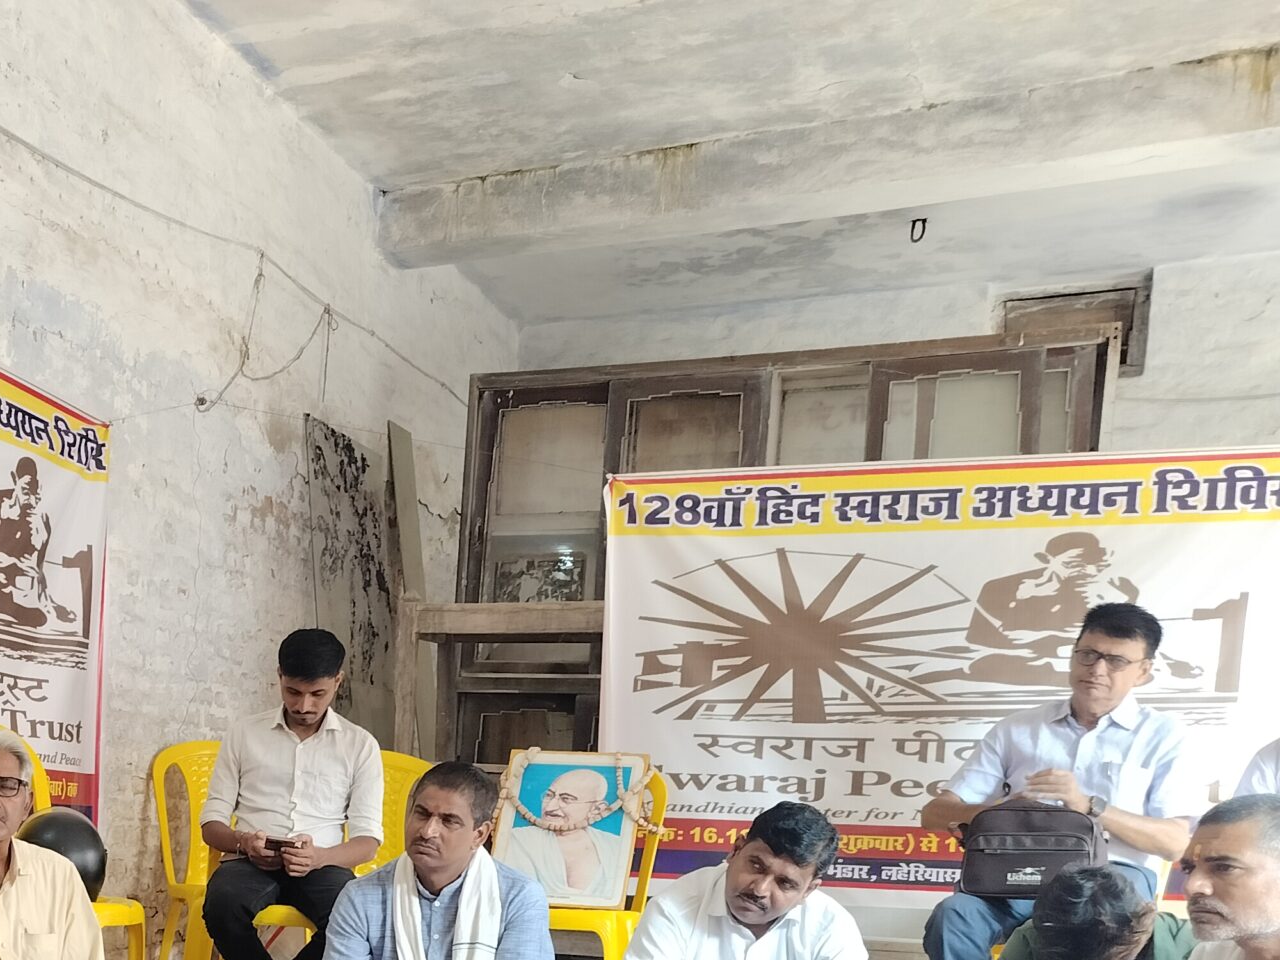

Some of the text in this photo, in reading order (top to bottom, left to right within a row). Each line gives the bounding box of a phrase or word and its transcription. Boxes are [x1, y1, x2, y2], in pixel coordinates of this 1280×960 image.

[754, 484, 826, 527] हिंद
[834, 488, 964, 523] स्वराज
[972, 480, 1143, 519] अध्ययन
[1152, 465, 1280, 514] शिवि
[0, 707, 83, 744] Trust
[692, 733, 875, 764] स्वराज
[654, 764, 828, 803] waraj
[858, 807, 905, 823] for
[837, 833, 916, 855] शुक्रवार)
[919, 832, 940, 853] से
